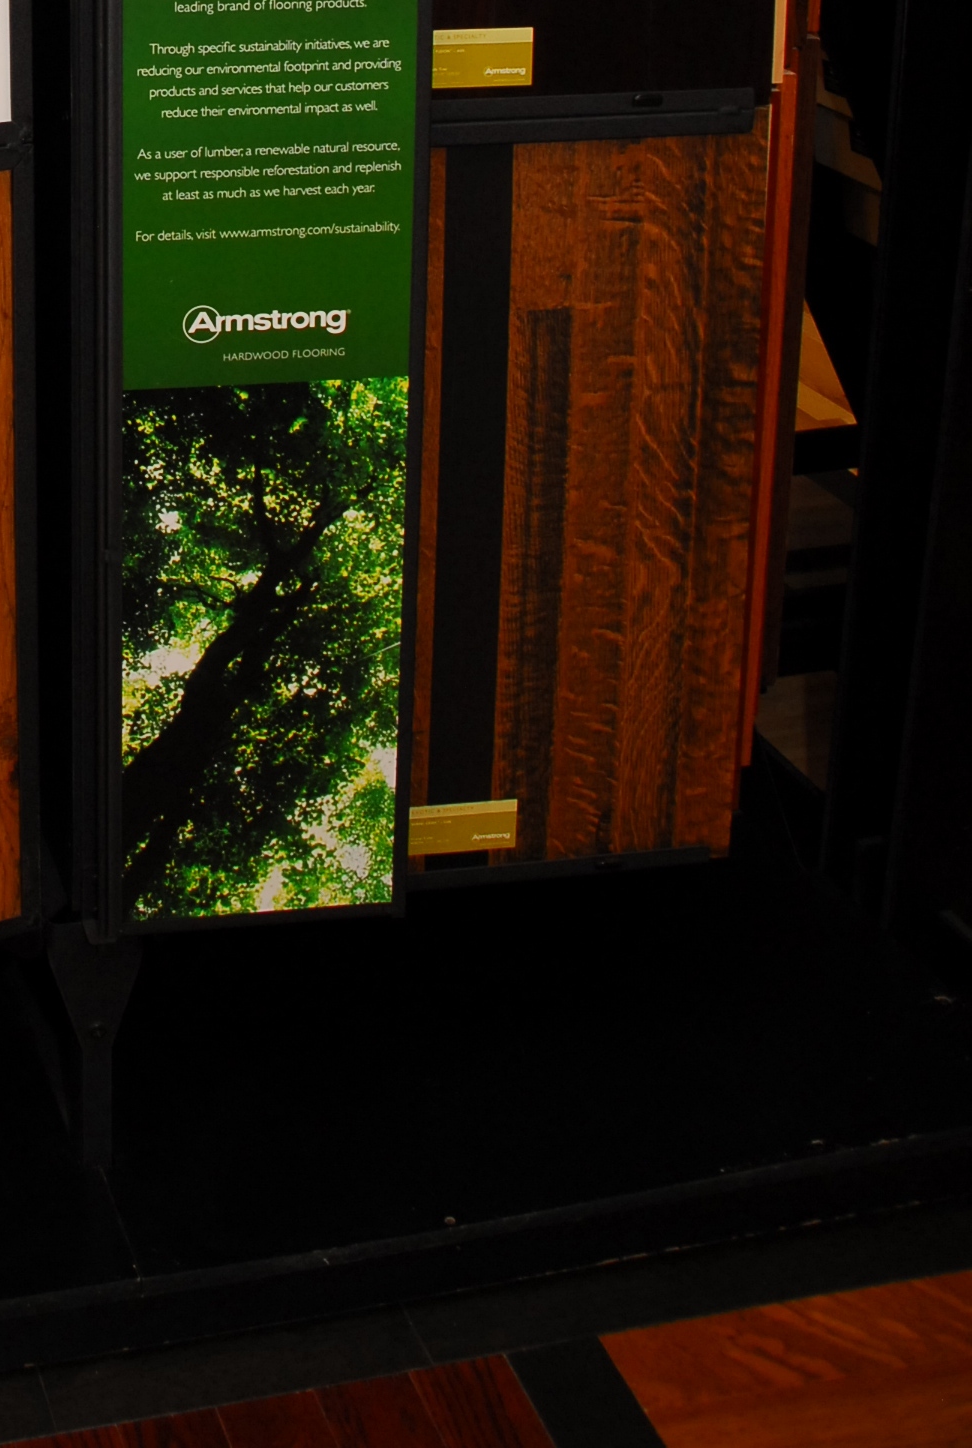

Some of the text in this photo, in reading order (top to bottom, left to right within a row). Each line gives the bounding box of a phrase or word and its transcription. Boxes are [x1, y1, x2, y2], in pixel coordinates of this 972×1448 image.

[175, 1, 214, 15] leading
[218, 0, 250, 11] brand
[254, 0, 267, 10] of
[149, 39, 389, 57] Through specific sustainability initiatives, we are
[137, 58, 401, 78] reducing our environmental footprint and providing
[484, 67, 526, 77] Armstrong
[150, 82, 389, 100] products and services that help our customers
[162, 101, 377, 118] reduce their environmental impact as well.
[137, 142, 400, 159] As a user of lumber, a renewable natural resource,
[155, 170, 197, 182] support
[200, 166, 259, 180] responsible
[263, 164, 329, 176] reforestation
[333, 162, 352, 173] and
[355, 161, 401, 175] replenish
[162, 192, 173, 200] at
[176, 190, 199, 200] least
[203, 191, 214, 199] as
[217, 187, 246, 198] much
[250, 189, 260, 197] as
[283, 186, 322, 196] harvest
[325, 183, 349, 194] each
[352, 185, 375, 196] year.
[136, 231, 155, 241] For
[158, 230, 193, 241] details,
[196, 229, 216, 239] visit
[183, 305, 347, 343] Armstrong
[223, 348, 345, 361] HARDWOOD FLOORING
